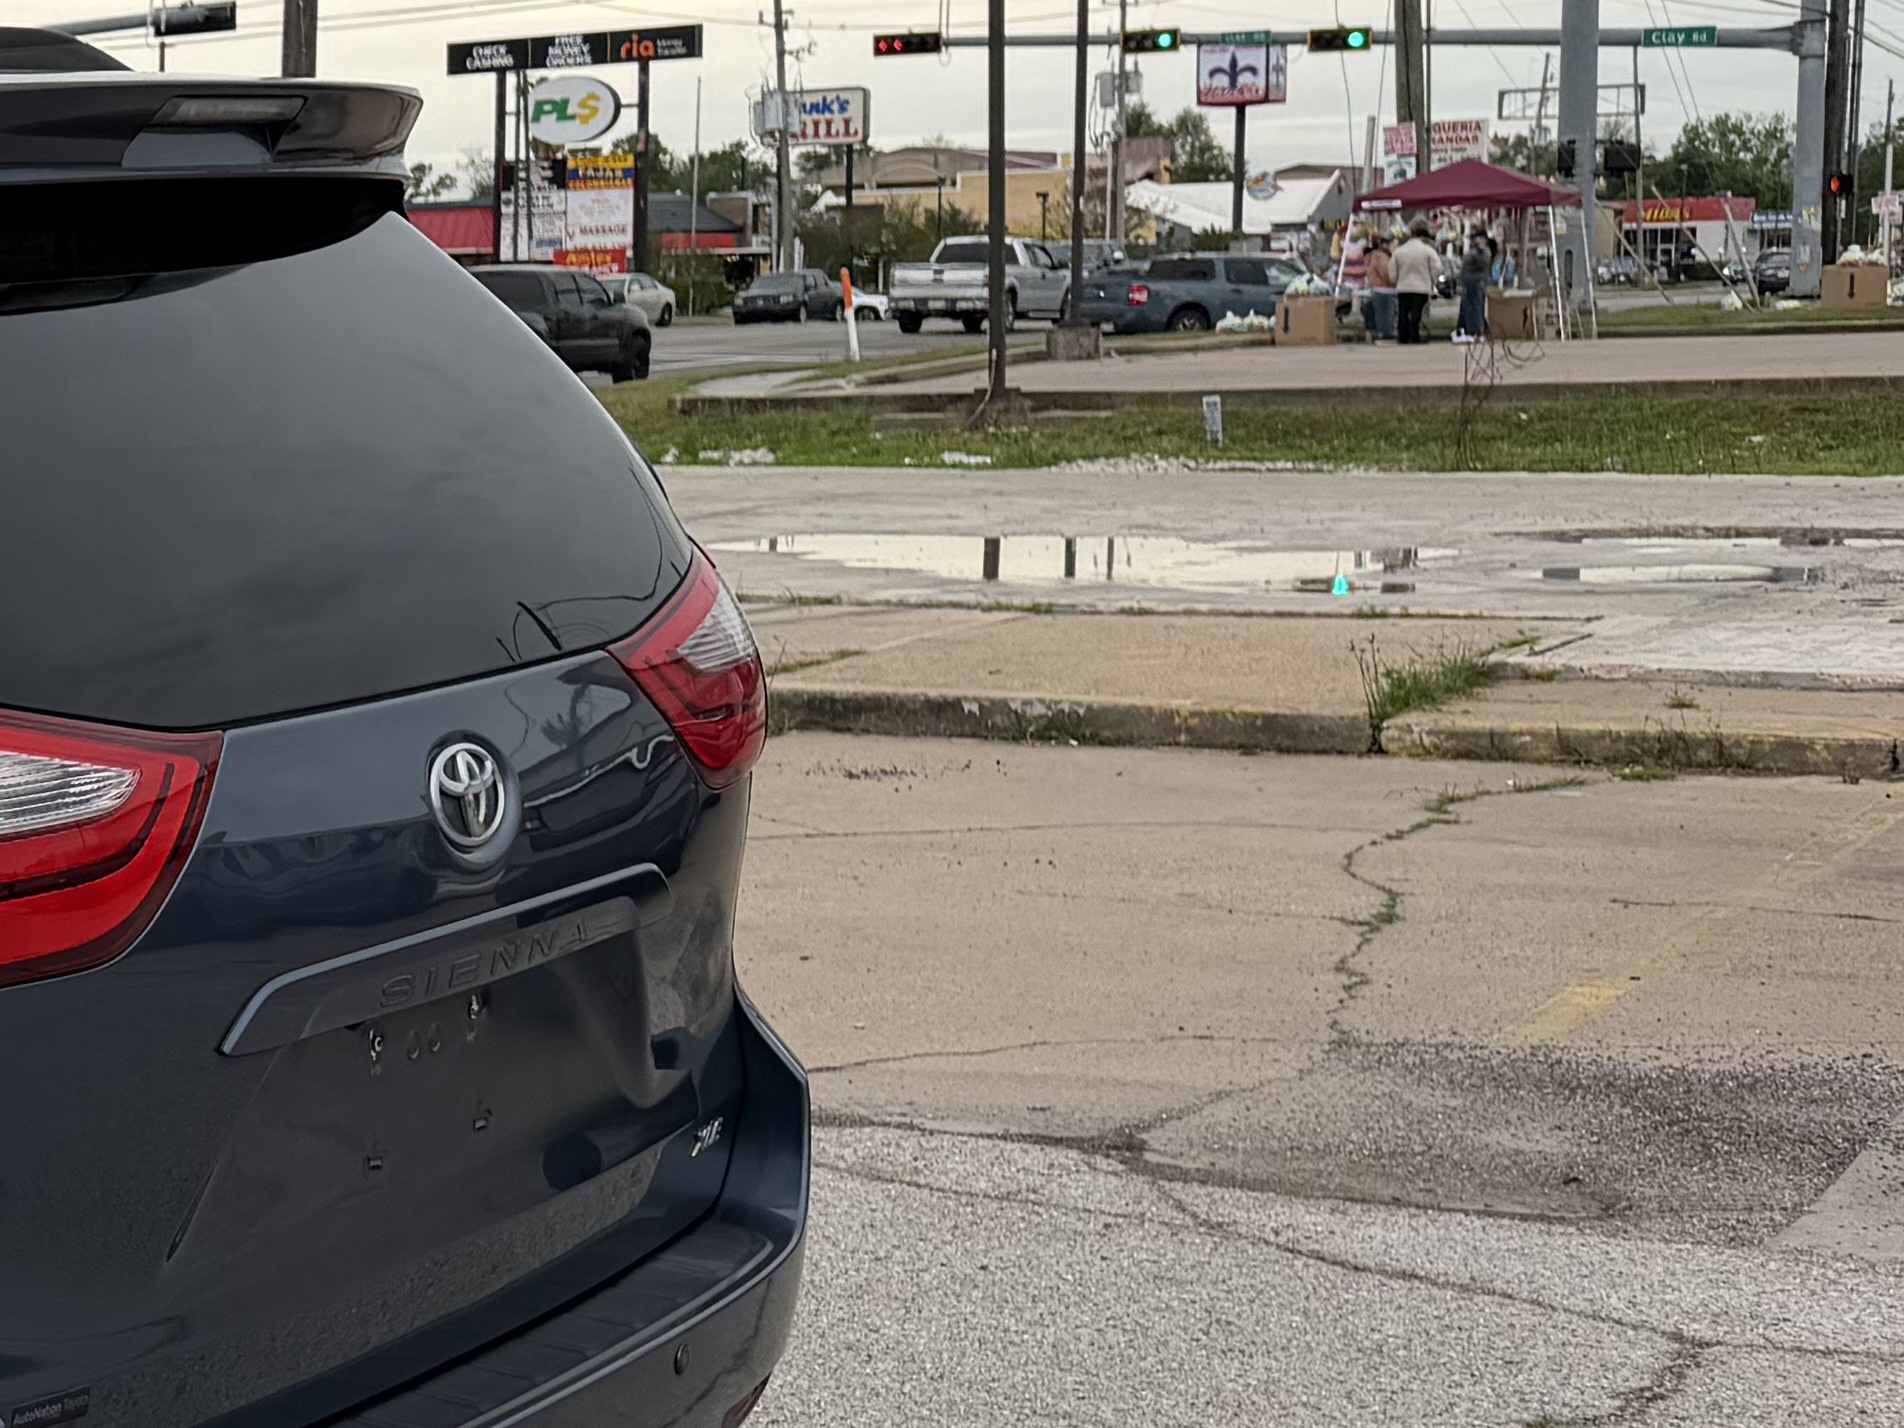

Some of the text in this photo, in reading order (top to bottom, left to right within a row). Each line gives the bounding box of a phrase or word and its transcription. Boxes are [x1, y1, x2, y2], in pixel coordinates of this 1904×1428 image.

[620, 33, 655, 60] ria
[1651, 30, 1707, 45] Clay Rd
[1432, 121, 1482, 134] QUERIA
[379, 915, 589, 1009] SIENNA
